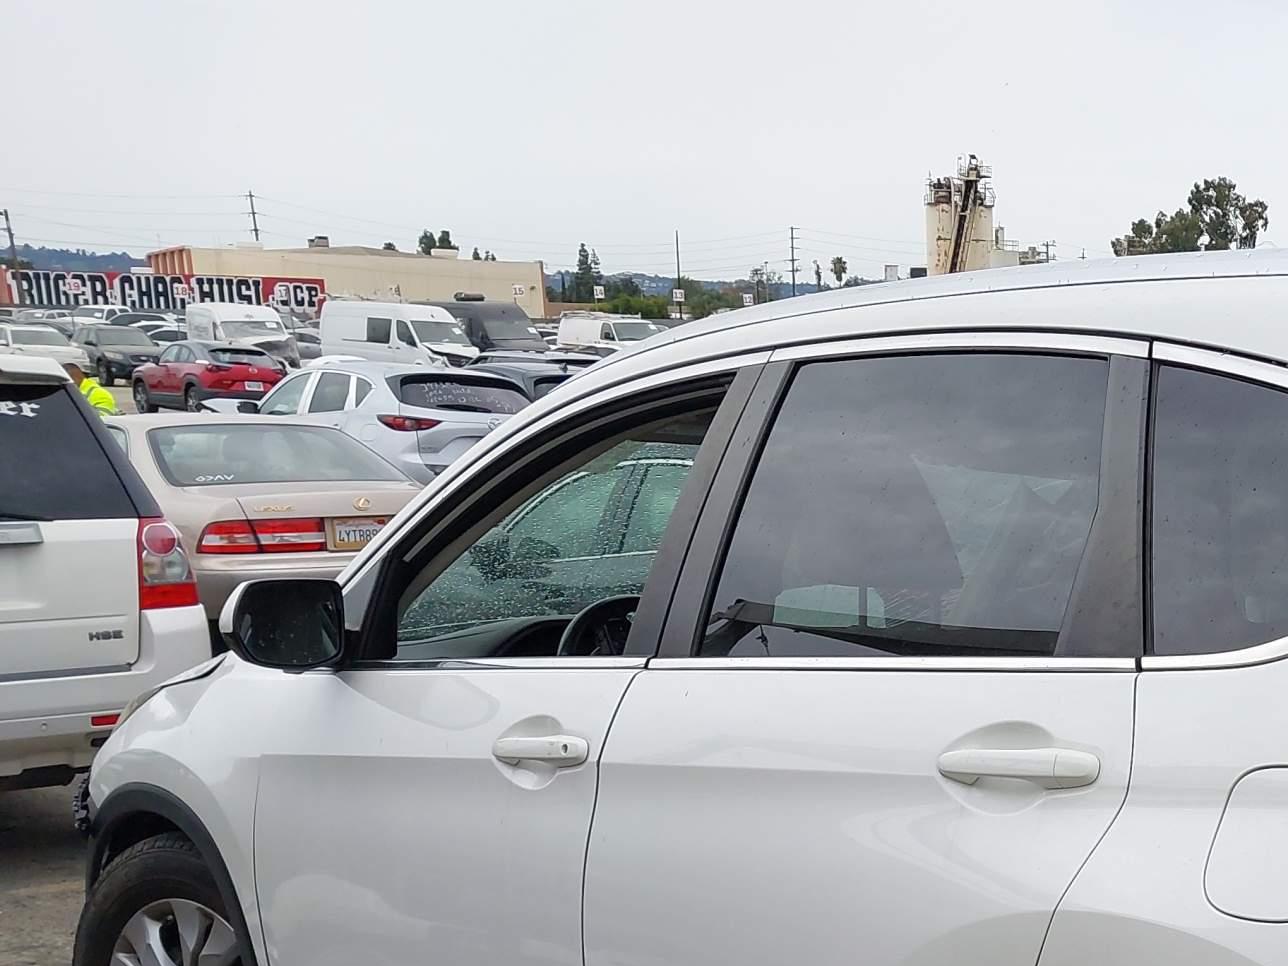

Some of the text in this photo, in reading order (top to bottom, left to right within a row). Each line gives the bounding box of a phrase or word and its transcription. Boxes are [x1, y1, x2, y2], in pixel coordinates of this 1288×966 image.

[67, 281, 81, 291] 19
[175, 286, 187, 296] 18
[513, 287, 524, 296] 15
[593, 287, 604, 297] 14
[674, 291, 684, 299] 13
[88, 629, 124, 641] HSE
